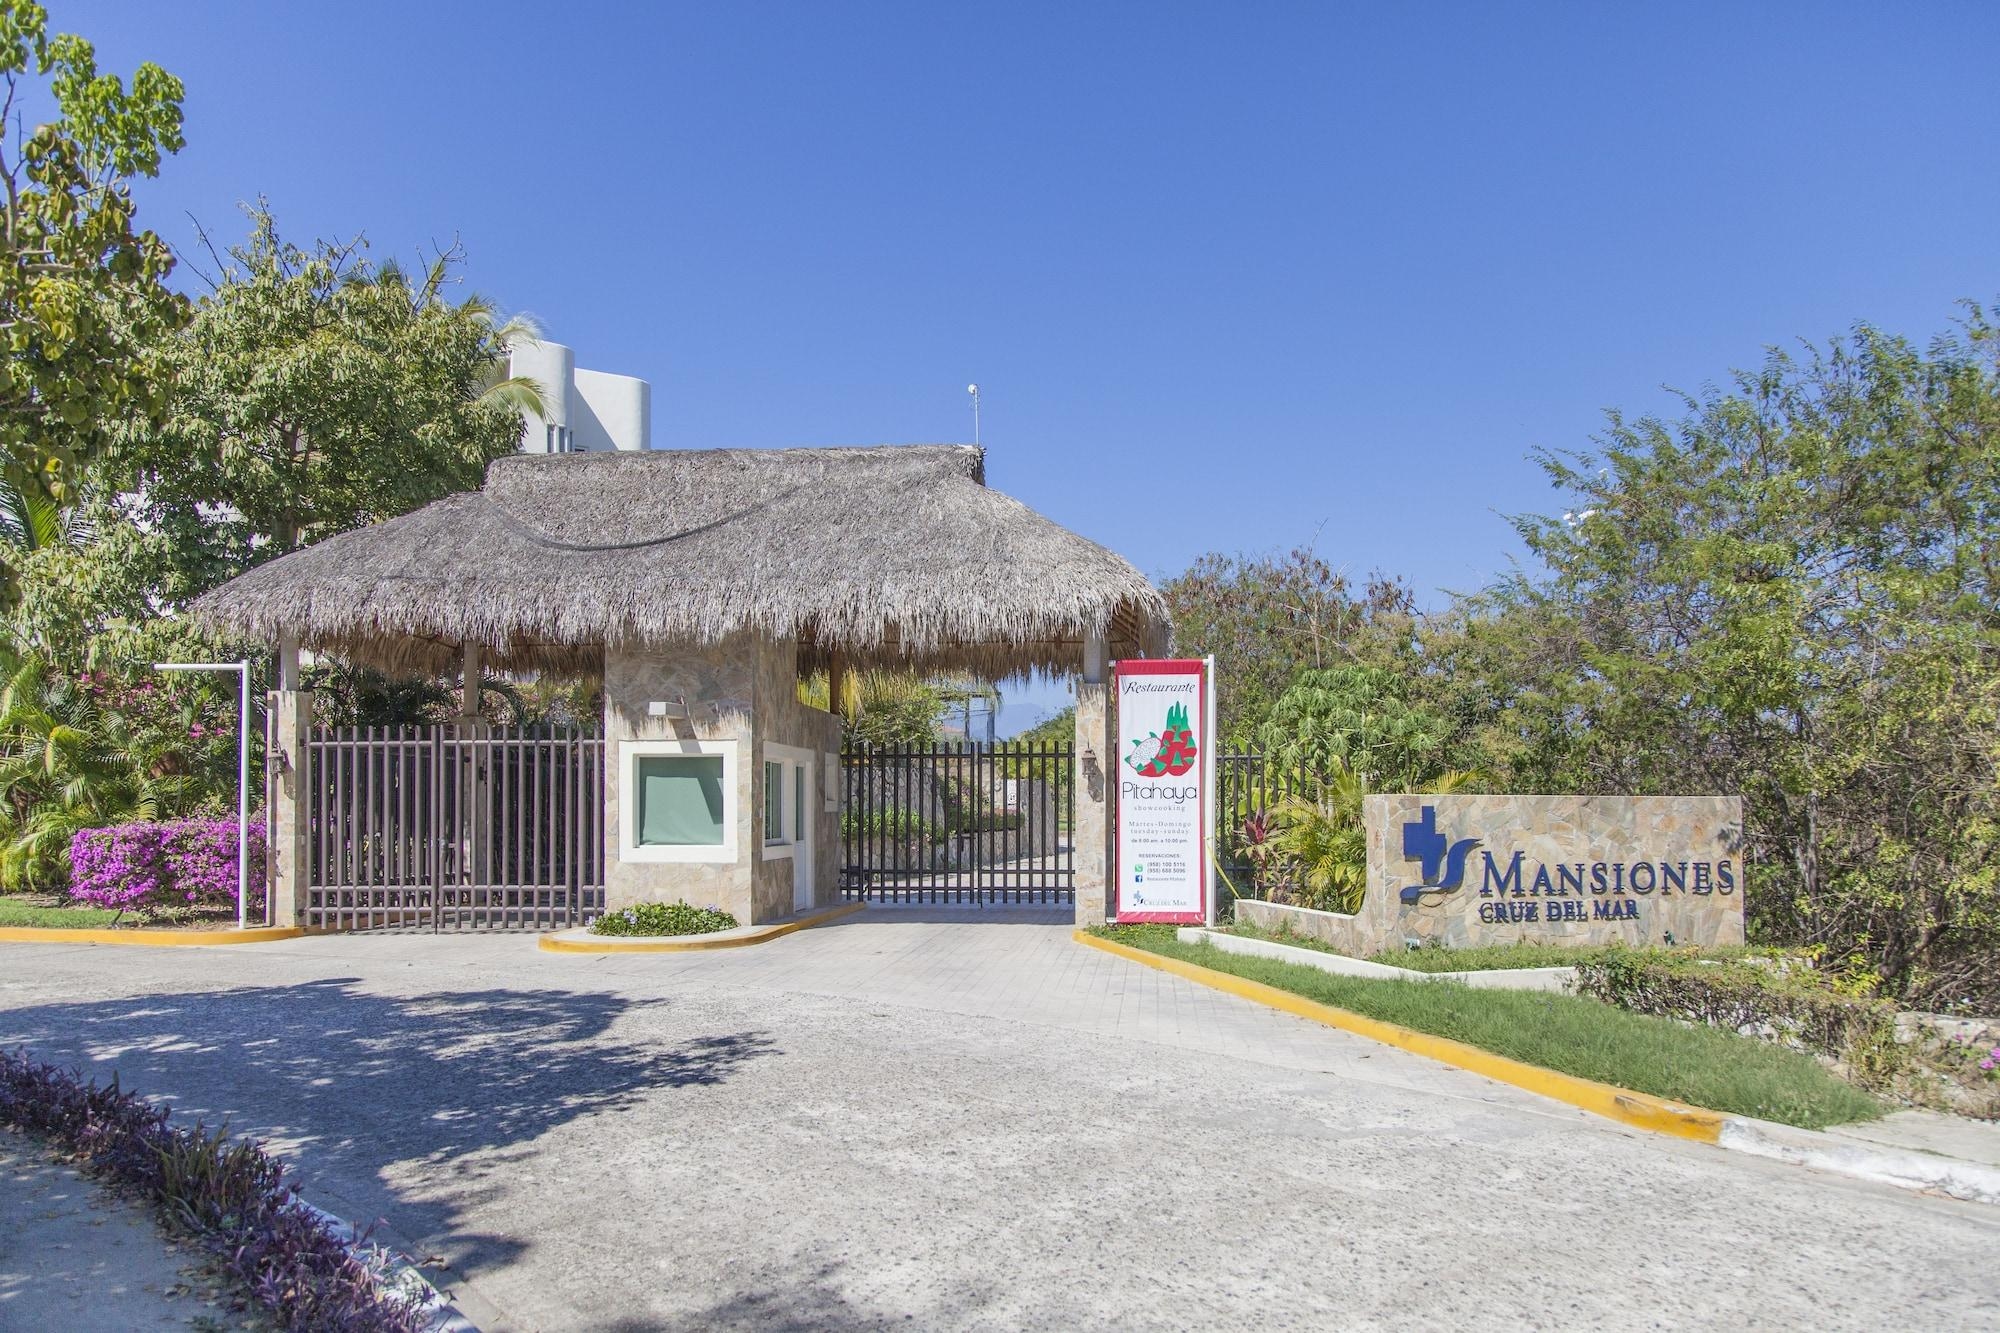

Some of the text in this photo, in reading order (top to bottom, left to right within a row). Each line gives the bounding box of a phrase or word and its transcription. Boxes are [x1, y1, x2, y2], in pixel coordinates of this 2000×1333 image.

[1124, 681, 1195, 695] Restaurante
[1122, 781, 1197, 804] Pitahaya
[1481, 850, 1735, 899] MANSIONES
[1480, 898, 1640, 924] CRUZ DEL MAR
